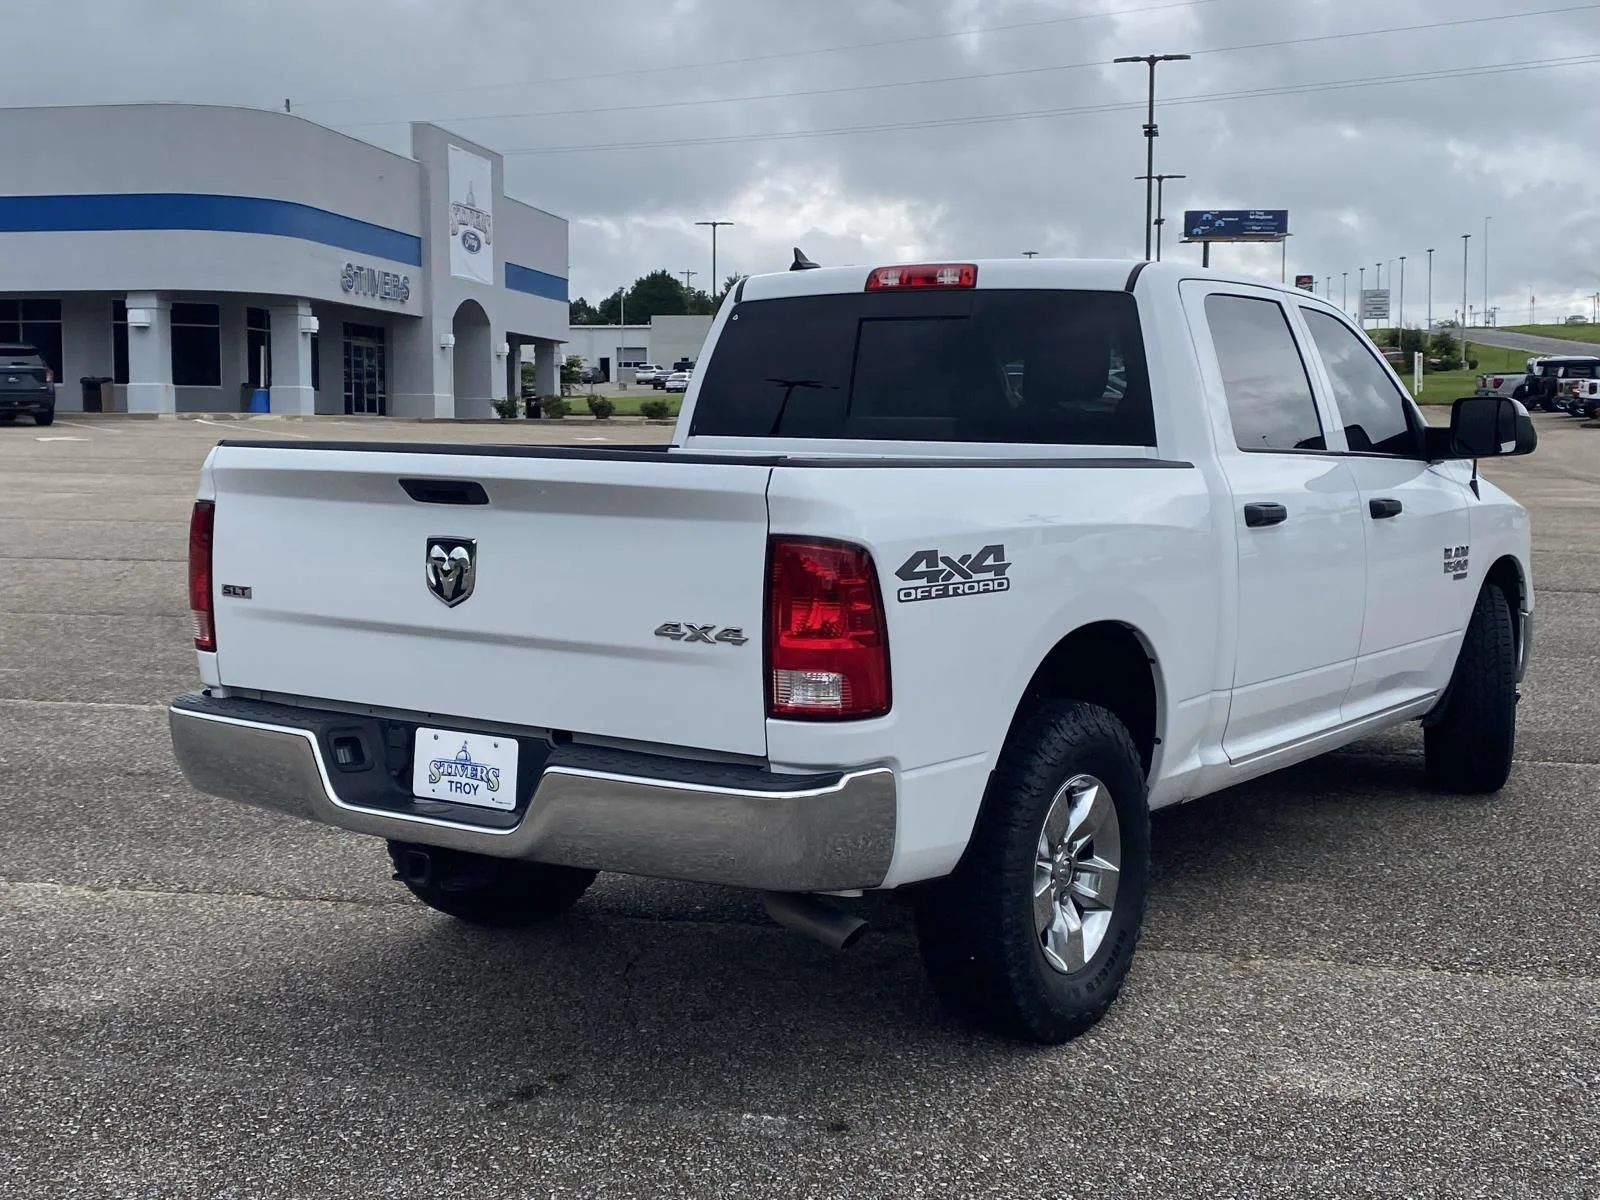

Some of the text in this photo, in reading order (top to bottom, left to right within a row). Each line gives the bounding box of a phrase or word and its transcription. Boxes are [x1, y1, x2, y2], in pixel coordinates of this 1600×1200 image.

[341, 263, 409, 302] STIVERS
[222, 584, 251, 598] SLT
[899, 579, 1008, 601] OFF ROAD
[429, 759, 499, 792] STIVERS
[447, 780, 480, 796] TROY
